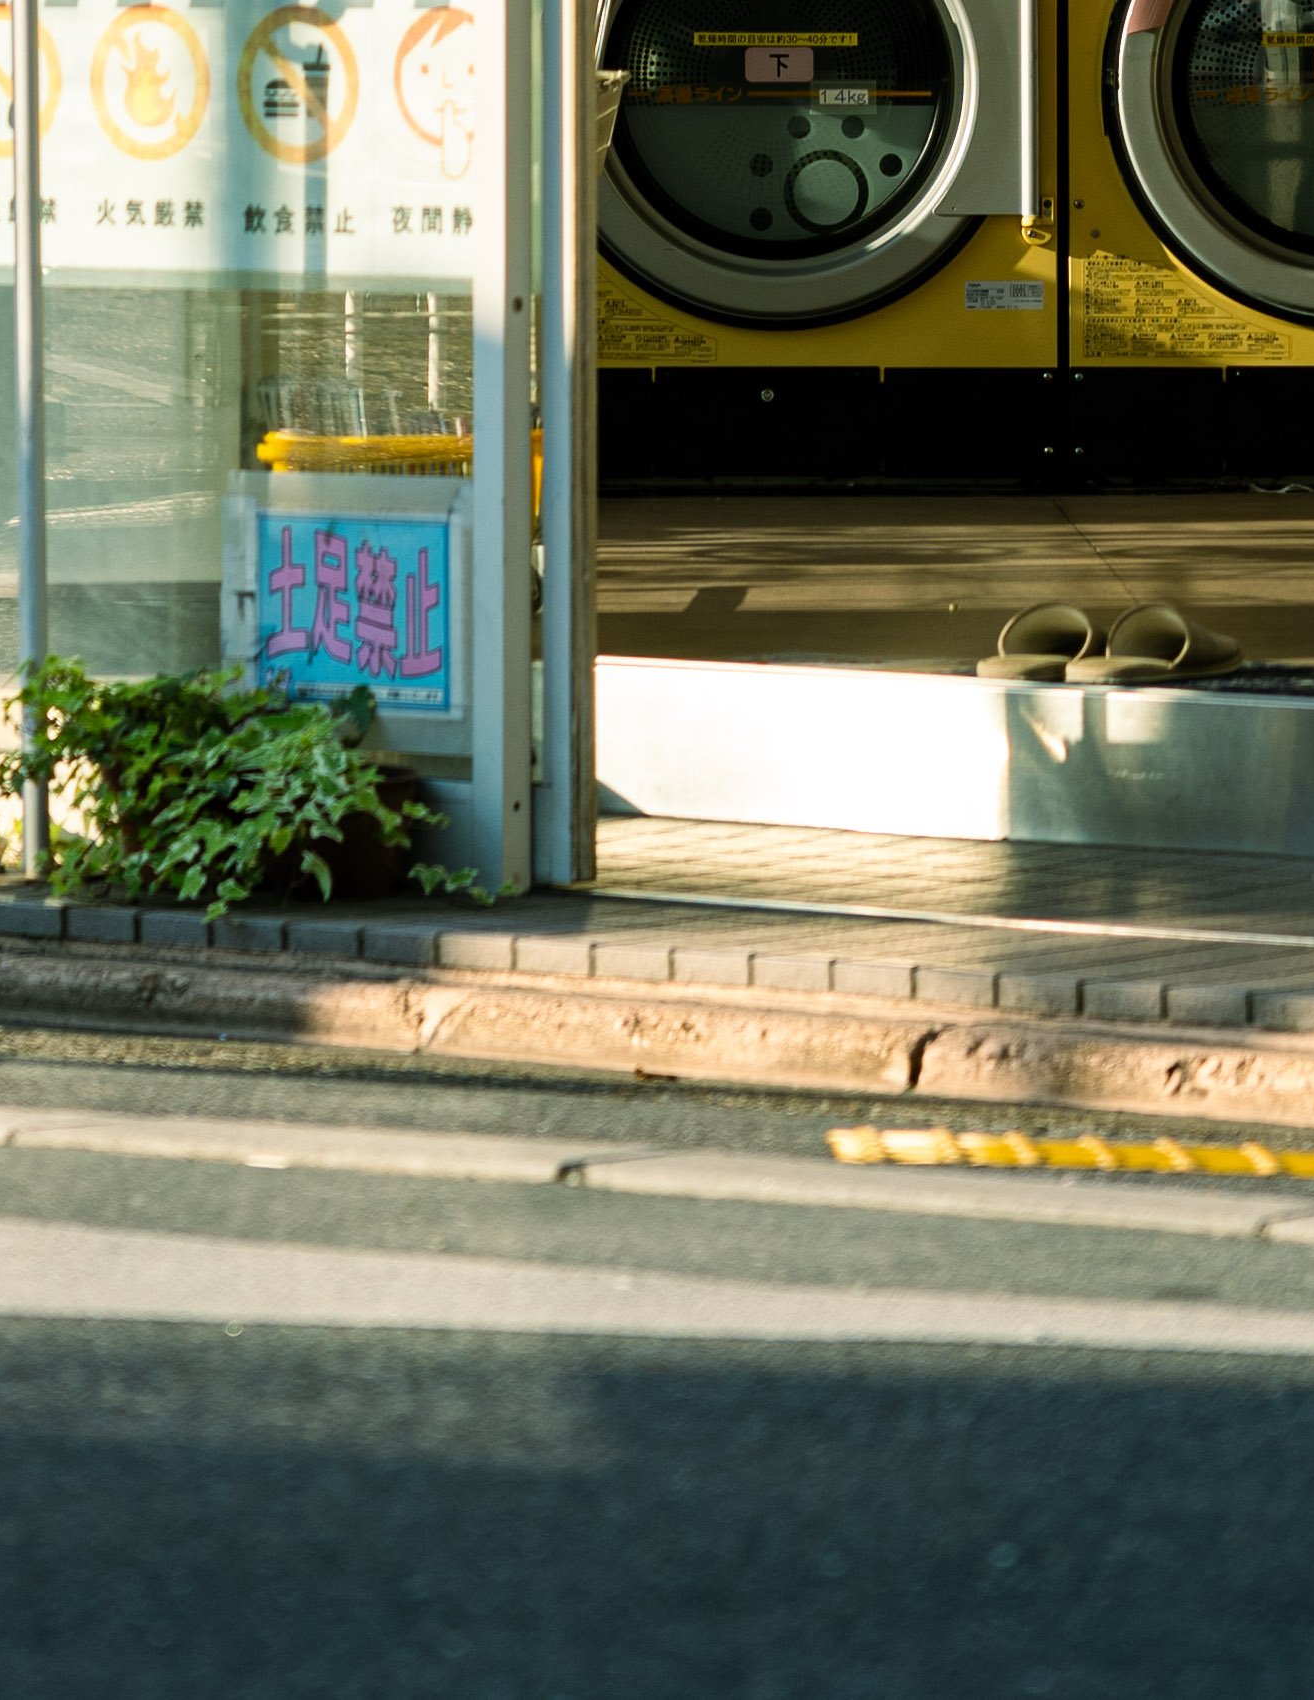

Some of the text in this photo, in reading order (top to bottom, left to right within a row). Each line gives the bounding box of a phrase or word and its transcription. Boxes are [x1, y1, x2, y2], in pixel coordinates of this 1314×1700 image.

[769, 54, 789, 79] 下
[97, 199, 205, 228] 火気厳禁
[243, 203, 356, 236] 飲食禁止
[267, 525, 442, 680] 土足禁止
